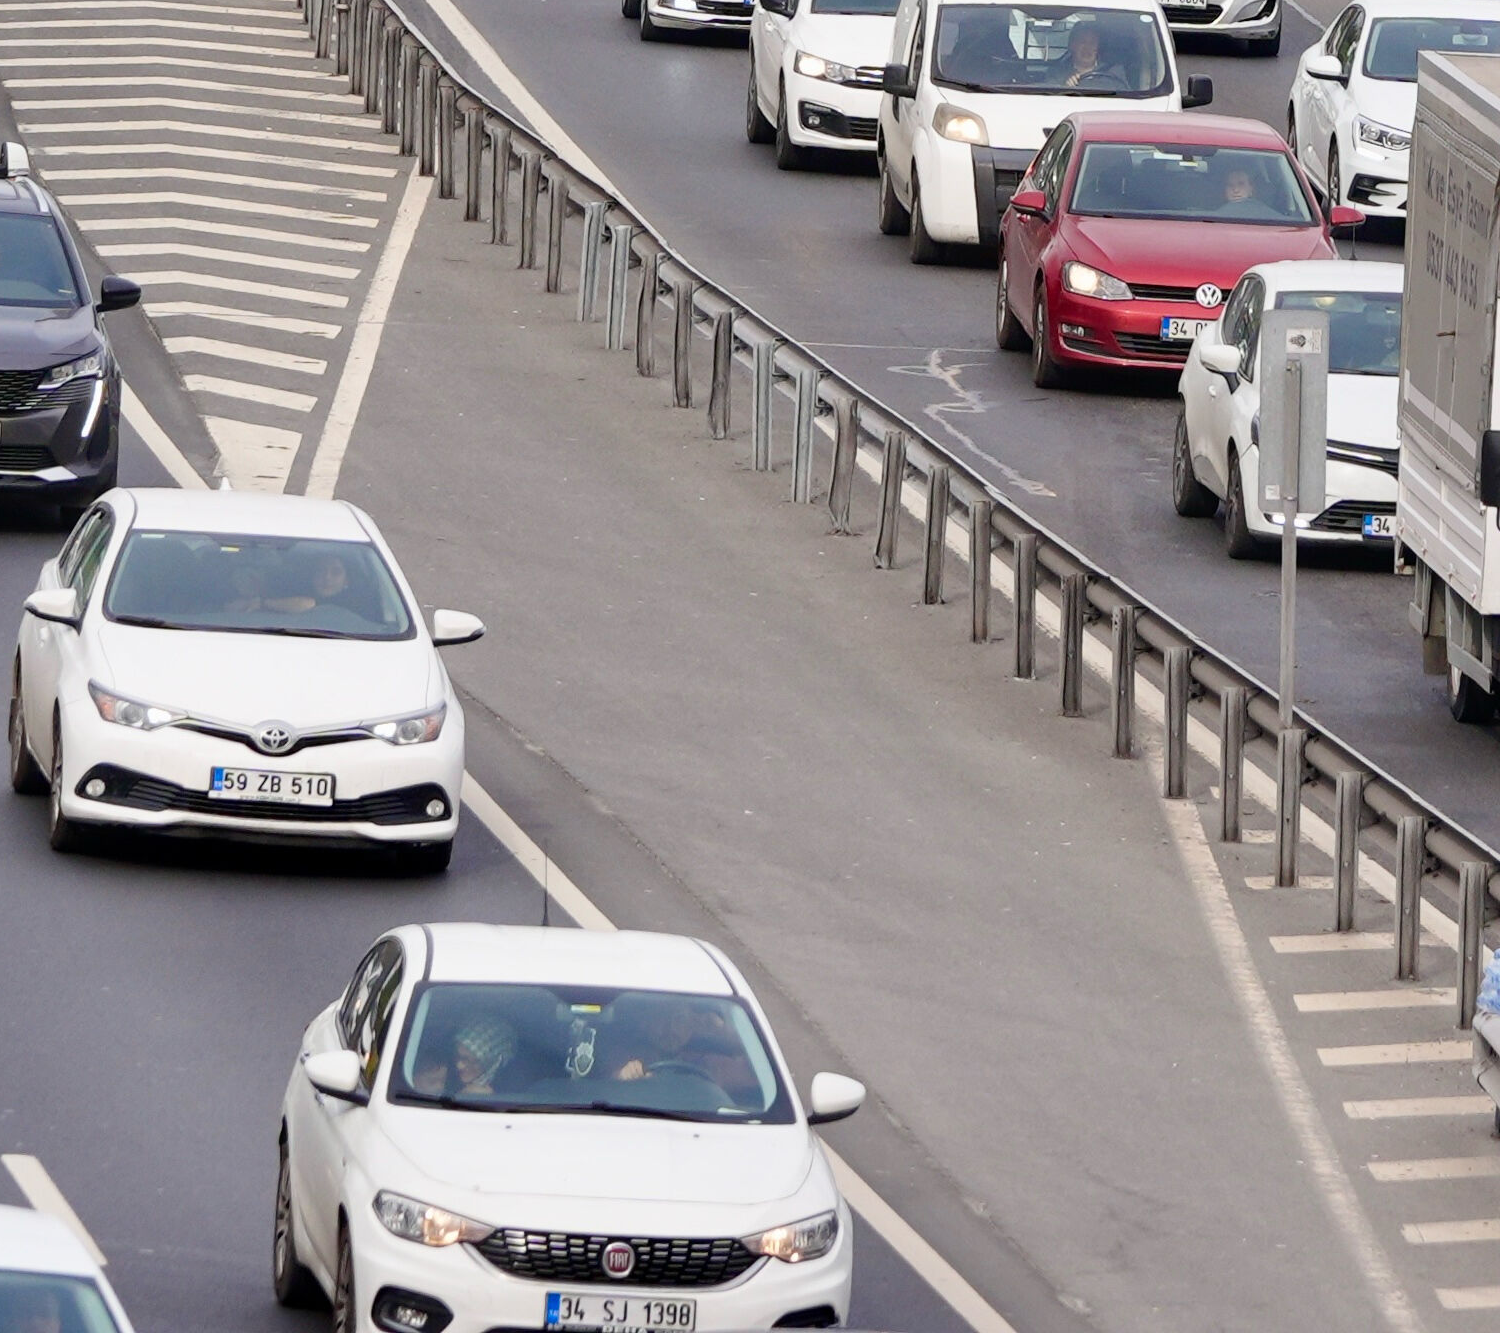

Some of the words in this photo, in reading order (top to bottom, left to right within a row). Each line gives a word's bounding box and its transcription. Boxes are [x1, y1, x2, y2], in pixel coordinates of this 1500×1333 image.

[1170, 322, 1188, 337] 34
[1373, 517, 1391, 534] 34
[223, 771, 248, 791] 59
[257, 773, 282, 793] ZB
[290, 775, 329, 797] 510
[560, 1296, 586, 1321] 34
[602, 1298, 629, 1324] SJ
[643, 1302, 692, 1326] 1398
